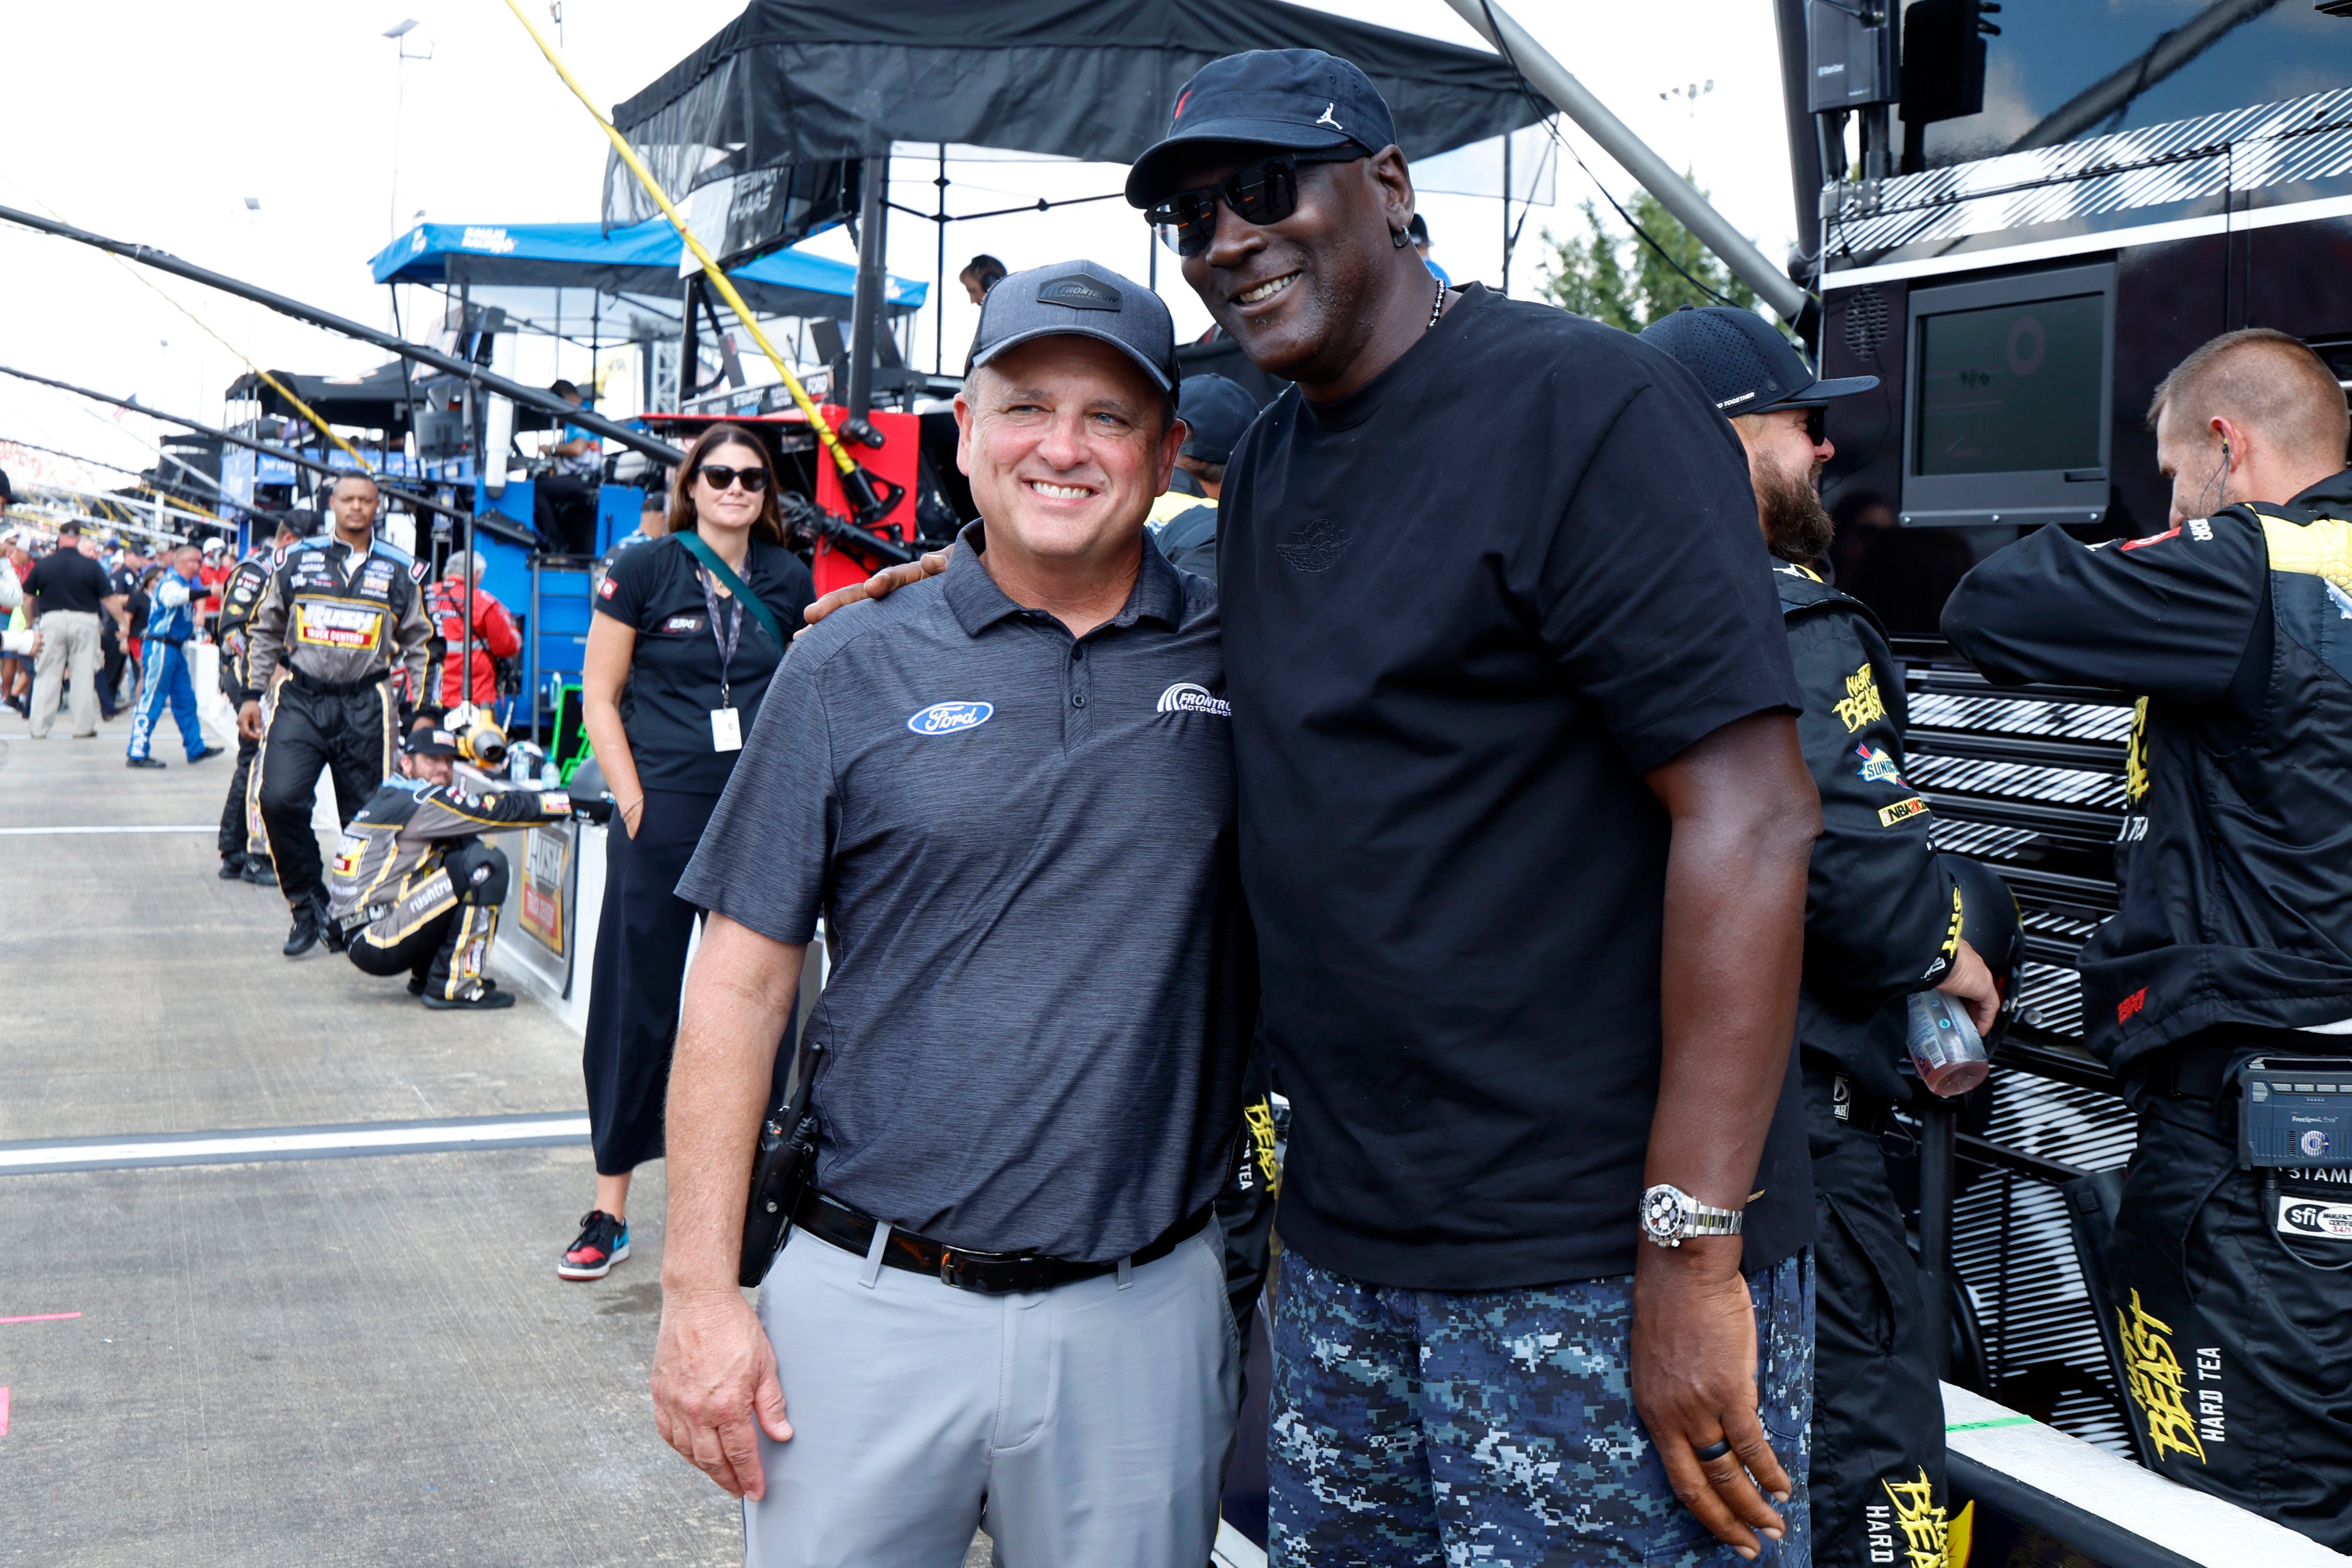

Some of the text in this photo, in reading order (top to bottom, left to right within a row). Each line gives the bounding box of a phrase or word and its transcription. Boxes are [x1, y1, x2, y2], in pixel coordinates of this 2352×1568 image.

[806, 374, 828, 395] FORD
[733, 388, 765, 408] STEWART
[1724, 392, 1755, 406] TOGETHER
[304, 604, 377, 631] RUSH
[307, 627, 329, 640] TRUCK
[925, 705, 977, 731] Ford
[409, 877, 453, 913] rushtru
[1239, 1163, 1254, 1190] TEA
[2291, 1207, 2317, 1226] sfi
[2323, 1213, 2352, 1221] MANUFACT
[2129, 1287, 2206, 1464] BEAST
[2196, 1347, 2225, 1442] HARD TEA
[1866, 1505, 1894, 1563] HARD
